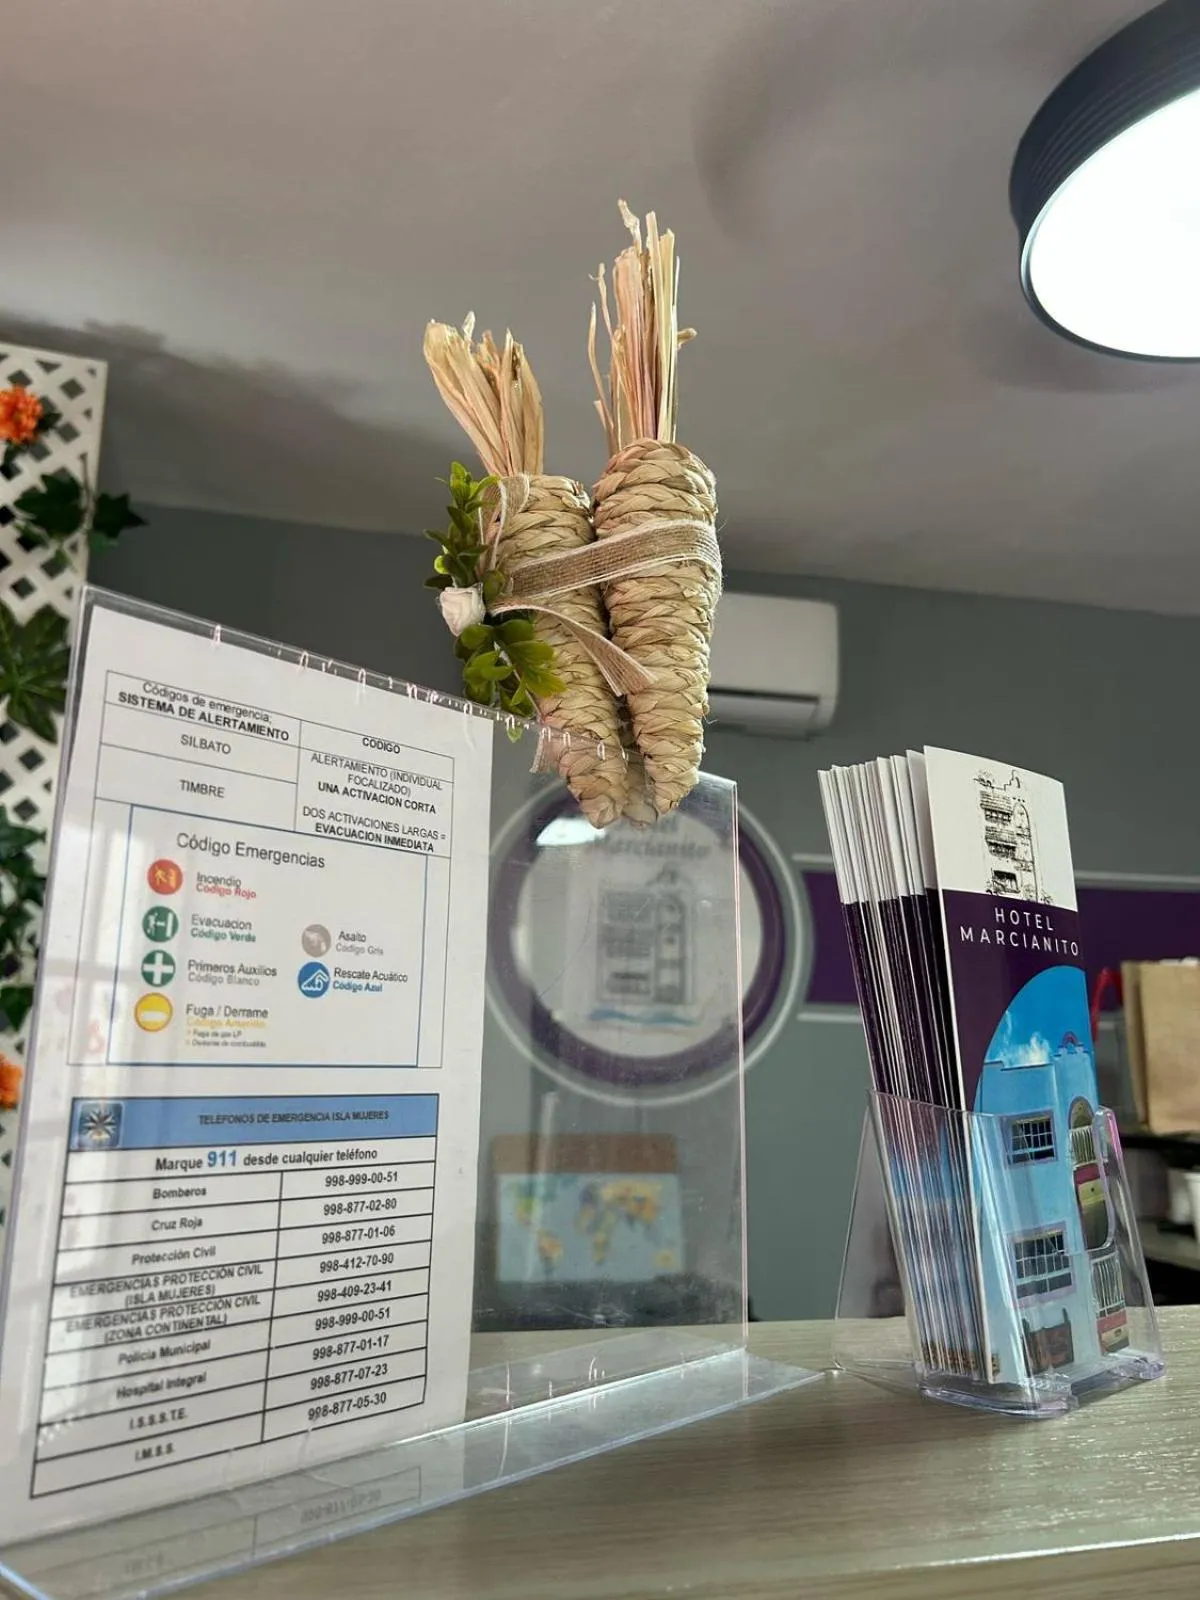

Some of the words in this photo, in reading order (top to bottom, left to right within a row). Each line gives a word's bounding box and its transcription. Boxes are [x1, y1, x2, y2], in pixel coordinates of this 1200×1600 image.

[143, 682, 188, 702] Códigos
[192, 695, 206, 707] de
[119, 692, 174, 714] SISTEMA
[178, 705, 196, 719] DE
[198, 711, 289, 740] ALERTAMIENTO
[180, 734, 231, 754] SILBATO
[362, 737, 400, 754] CODIGO
[311, 753, 387, 777] ALERTAMIENTO
[390, 771, 442, 790] (INDIVIDUAL
[179, 779, 225, 798] TIMBRE
[348, 774, 411, 796] FOCALIZADO)
[318, 781, 340, 794] UNA
[342, 787, 401, 807] ACTIVACION
[404, 799, 436, 814] CORTA
[303, 806, 326, 819] DOS
[328, 811, 399, 832] ACTIVACIONES
[402, 824, 438, 840] LARGAS
[315, 822, 382, 843] EVACUACION
[384, 835, 434, 852] INMEDIATA
[177, 832, 231, 857] Código
[235, 841, 325, 868] Emergencias
[196, 871, 242, 888] Incendio
[234, 887, 257, 901] Rojo
[994, 907, 1054, 931] HOTEL
[228, 931, 256, 943] Verde
[338, 931, 366, 943] Asalto
[960, 925, 1079, 957] MARCIANITO
[188, 959, 235, 974] Primeros
[237, 963, 277, 977] Auxilios
[334, 967, 371, 980] Rescate
[227, 974, 259, 986] Blanco
[364, 982, 383, 993] Azul
[186, 1004, 214, 1018] Fuga
[224, 1005, 268, 1018] Derrame
[257, 1113, 270, 1123] DE
[272, 1111, 331, 1123] EMERGENCIA
[332, 1110, 351, 1121] ISLA
[352, 1110, 389, 1121] MUJERES
[155, 1157, 203, 1172] Marque
[207, 1150, 237, 1167] 911
[243, 1152, 278, 1166] desde
[282, 1150, 334, 1165] cualquier
[336, 1149, 377, 1161] teléfono
[325, 1171, 398, 1187] 998-999-00-51
[153, 1187, 206, 1199] Bomberos
[323, 1198, 397, 1216] 998-877-02-80
[151, 1219, 177, 1231] Cruz
[180, 1217, 202, 1230] Roja
[322, 1225, 396, 1245] 998-877-01-06
[131, 1250, 190, 1265] Protección
[193, 1246, 216, 1257] Civil
[319, 1252, 394, 1273] 998-412-70-90
[237, 1264, 263, 1276] CIVIL
[234, 1294, 261, 1307] CIVIL
[317, 1280, 392, 1302] 998-409-23-41
[315, 1307, 391, 1331] 998-999-00-51
[159, 1338, 211, 1358] Municipal
[312, 1334, 389, 1360] 998-877-01-17
[310, 1363, 388, 1390] 998-877-07-23
[116, 1379, 164, 1399] Hospital
[308, 1391, 387, 1420] 998-877-05-30
